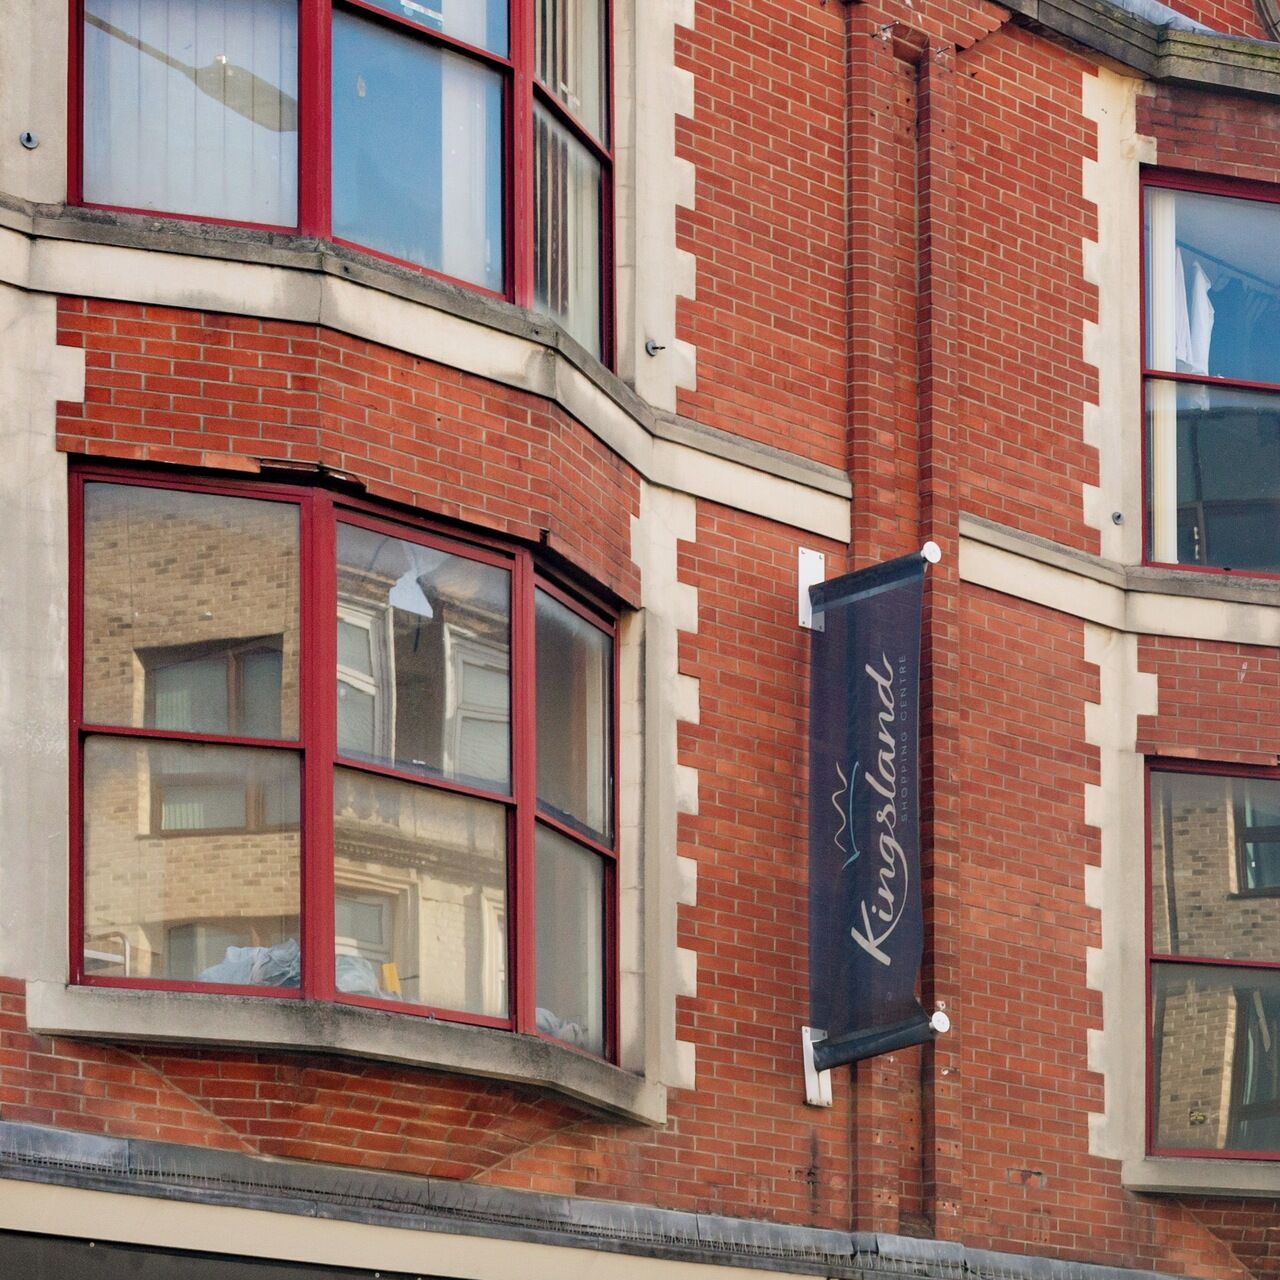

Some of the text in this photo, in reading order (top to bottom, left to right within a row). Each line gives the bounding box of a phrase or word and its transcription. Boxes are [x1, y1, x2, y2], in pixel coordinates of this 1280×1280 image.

[851, 651, 910, 967] Kingsland
[899, 655, 908, 822] SHOPPING CENTRE
